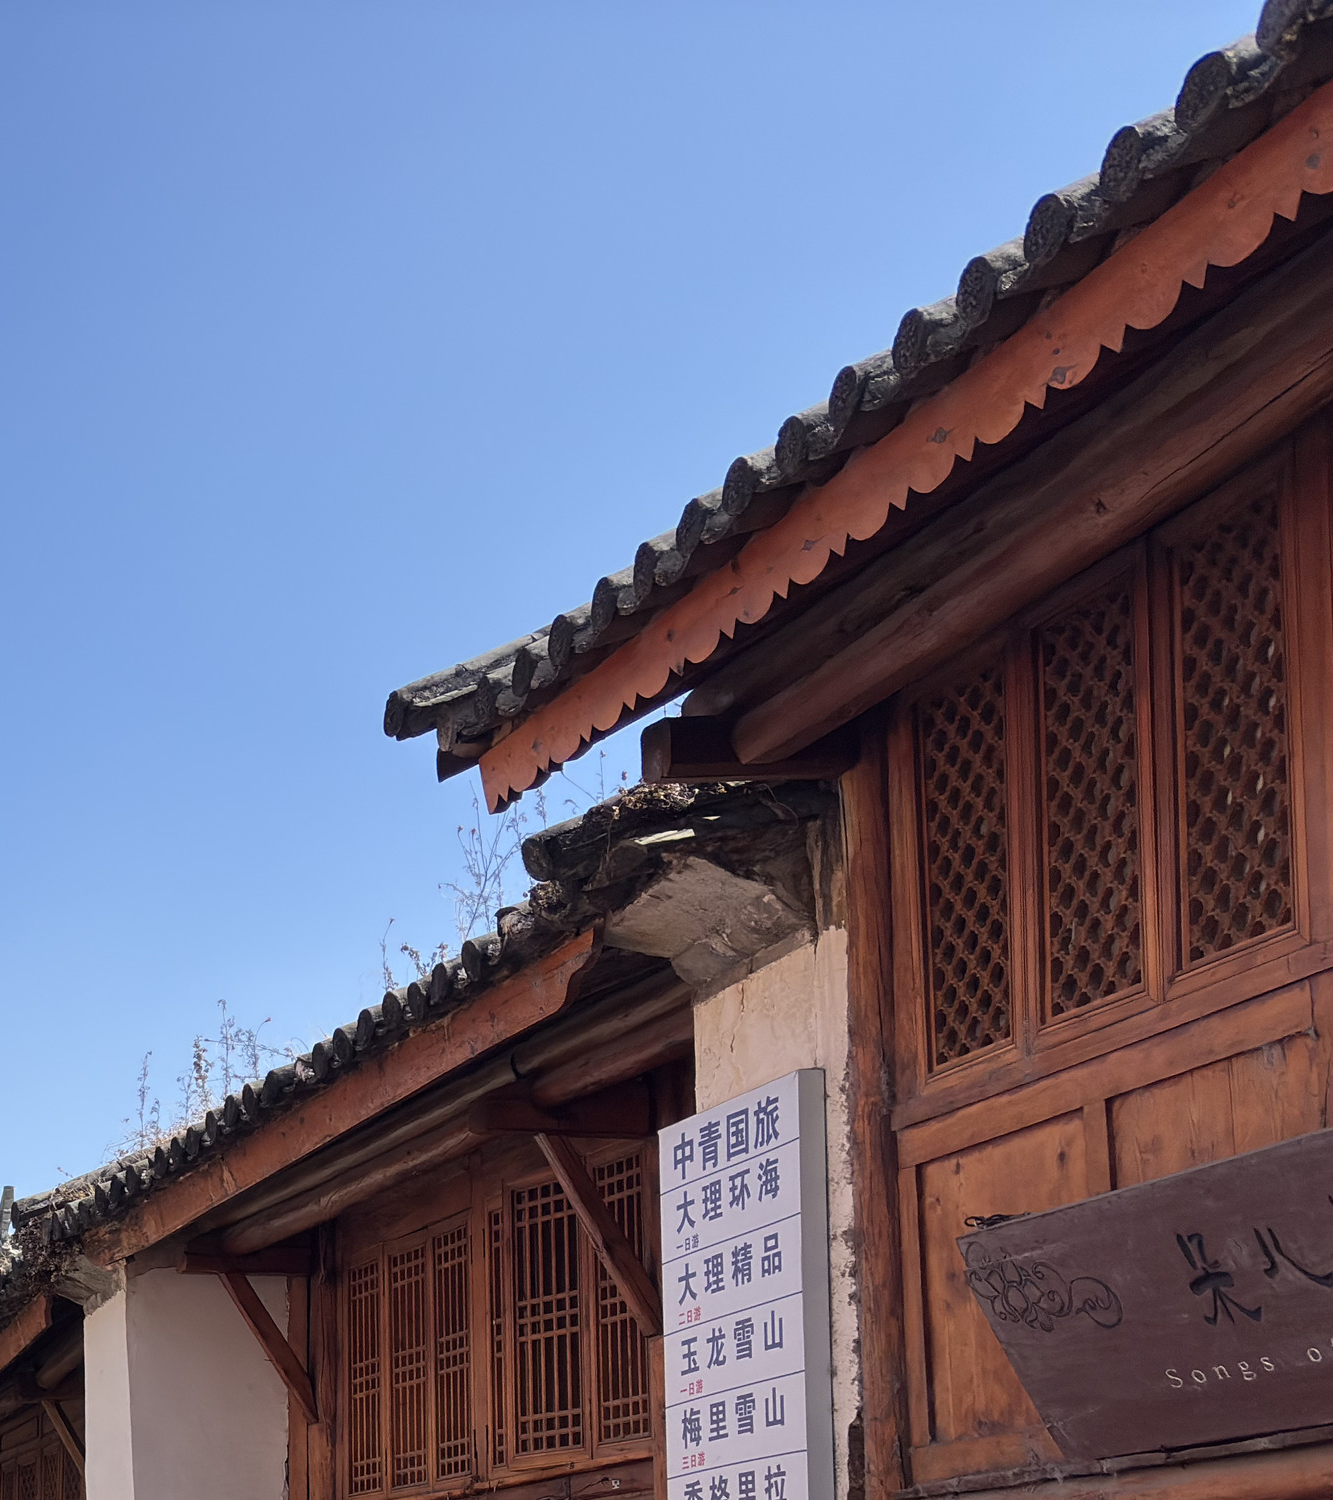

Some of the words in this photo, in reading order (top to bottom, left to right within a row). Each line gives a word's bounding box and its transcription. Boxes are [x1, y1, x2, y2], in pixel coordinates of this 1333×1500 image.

[673, 1095, 780, 1180] 中青国旅
[676, 1158, 780, 1234] 大理环海
[676, 1233, 699, 1251] 一日游
[678, 1232, 782, 1306] 大理精品
[678, 1306, 701, 1326] 二日游
[680, 1310, 784, 1376] 玉龙雪山
[680, 1379, 703, 1395] 一日游
[1165, 1356, 1275, 1388] Songs
[681, 1387, 785, 1449] 梅里雪山
[682, 1451, 706, 1470] 三日游
